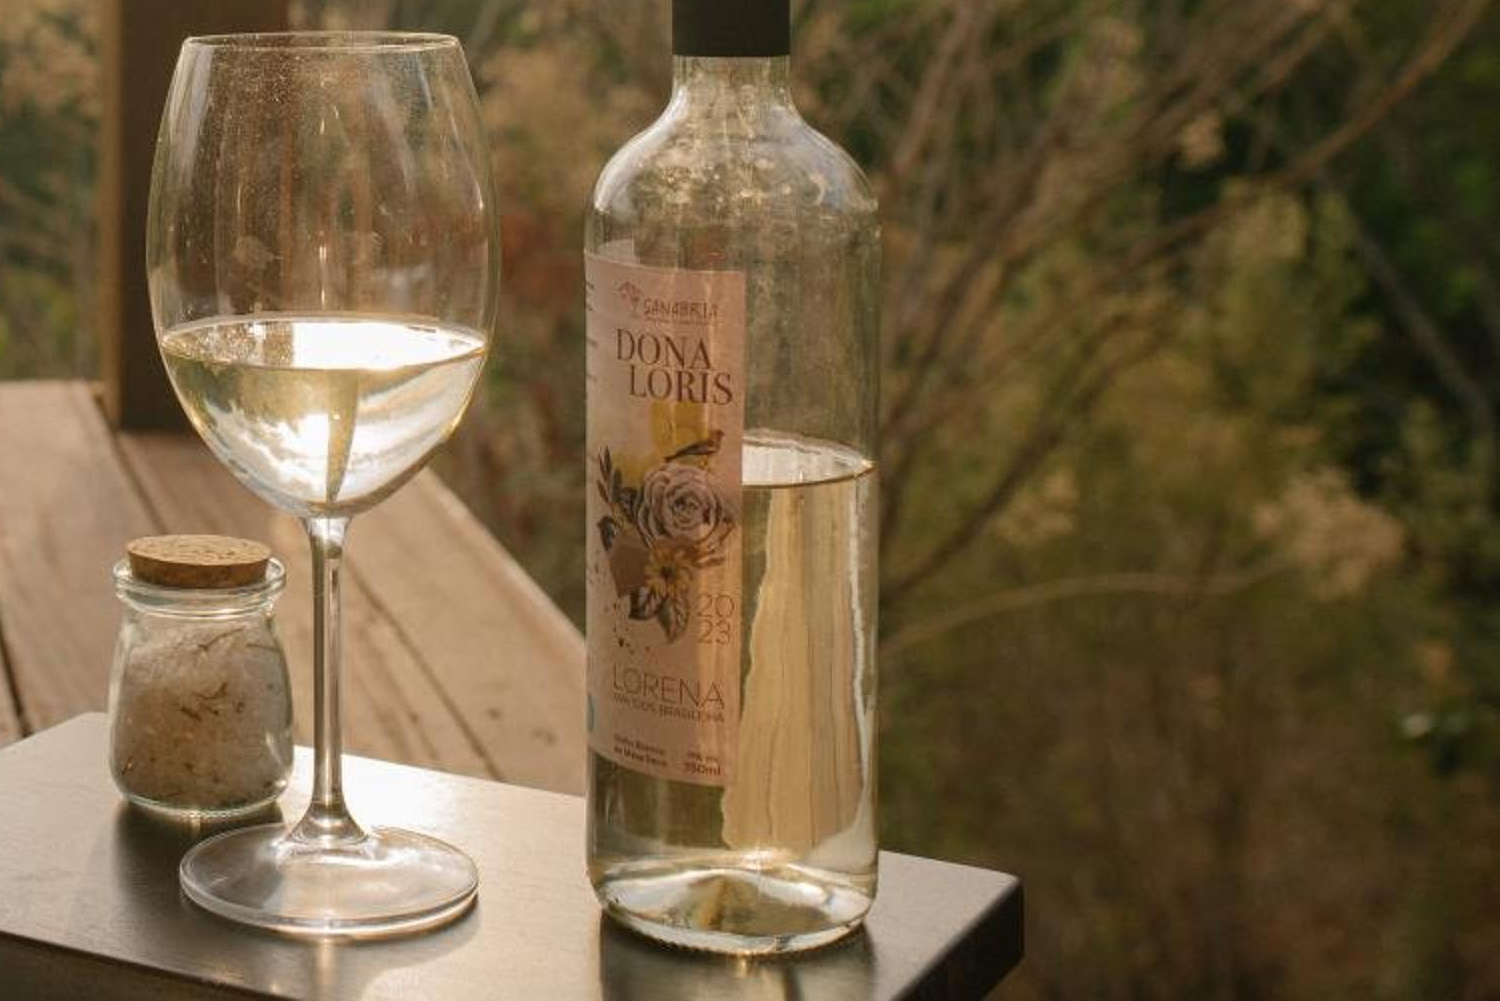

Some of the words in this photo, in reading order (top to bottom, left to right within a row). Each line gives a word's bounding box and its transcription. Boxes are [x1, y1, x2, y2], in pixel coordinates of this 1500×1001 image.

[616, 328, 711, 370] DONA
[629, 365, 733, 406] LORIS
[697, 594, 735, 618] 20
[612, 663, 725, 710] LORENA
